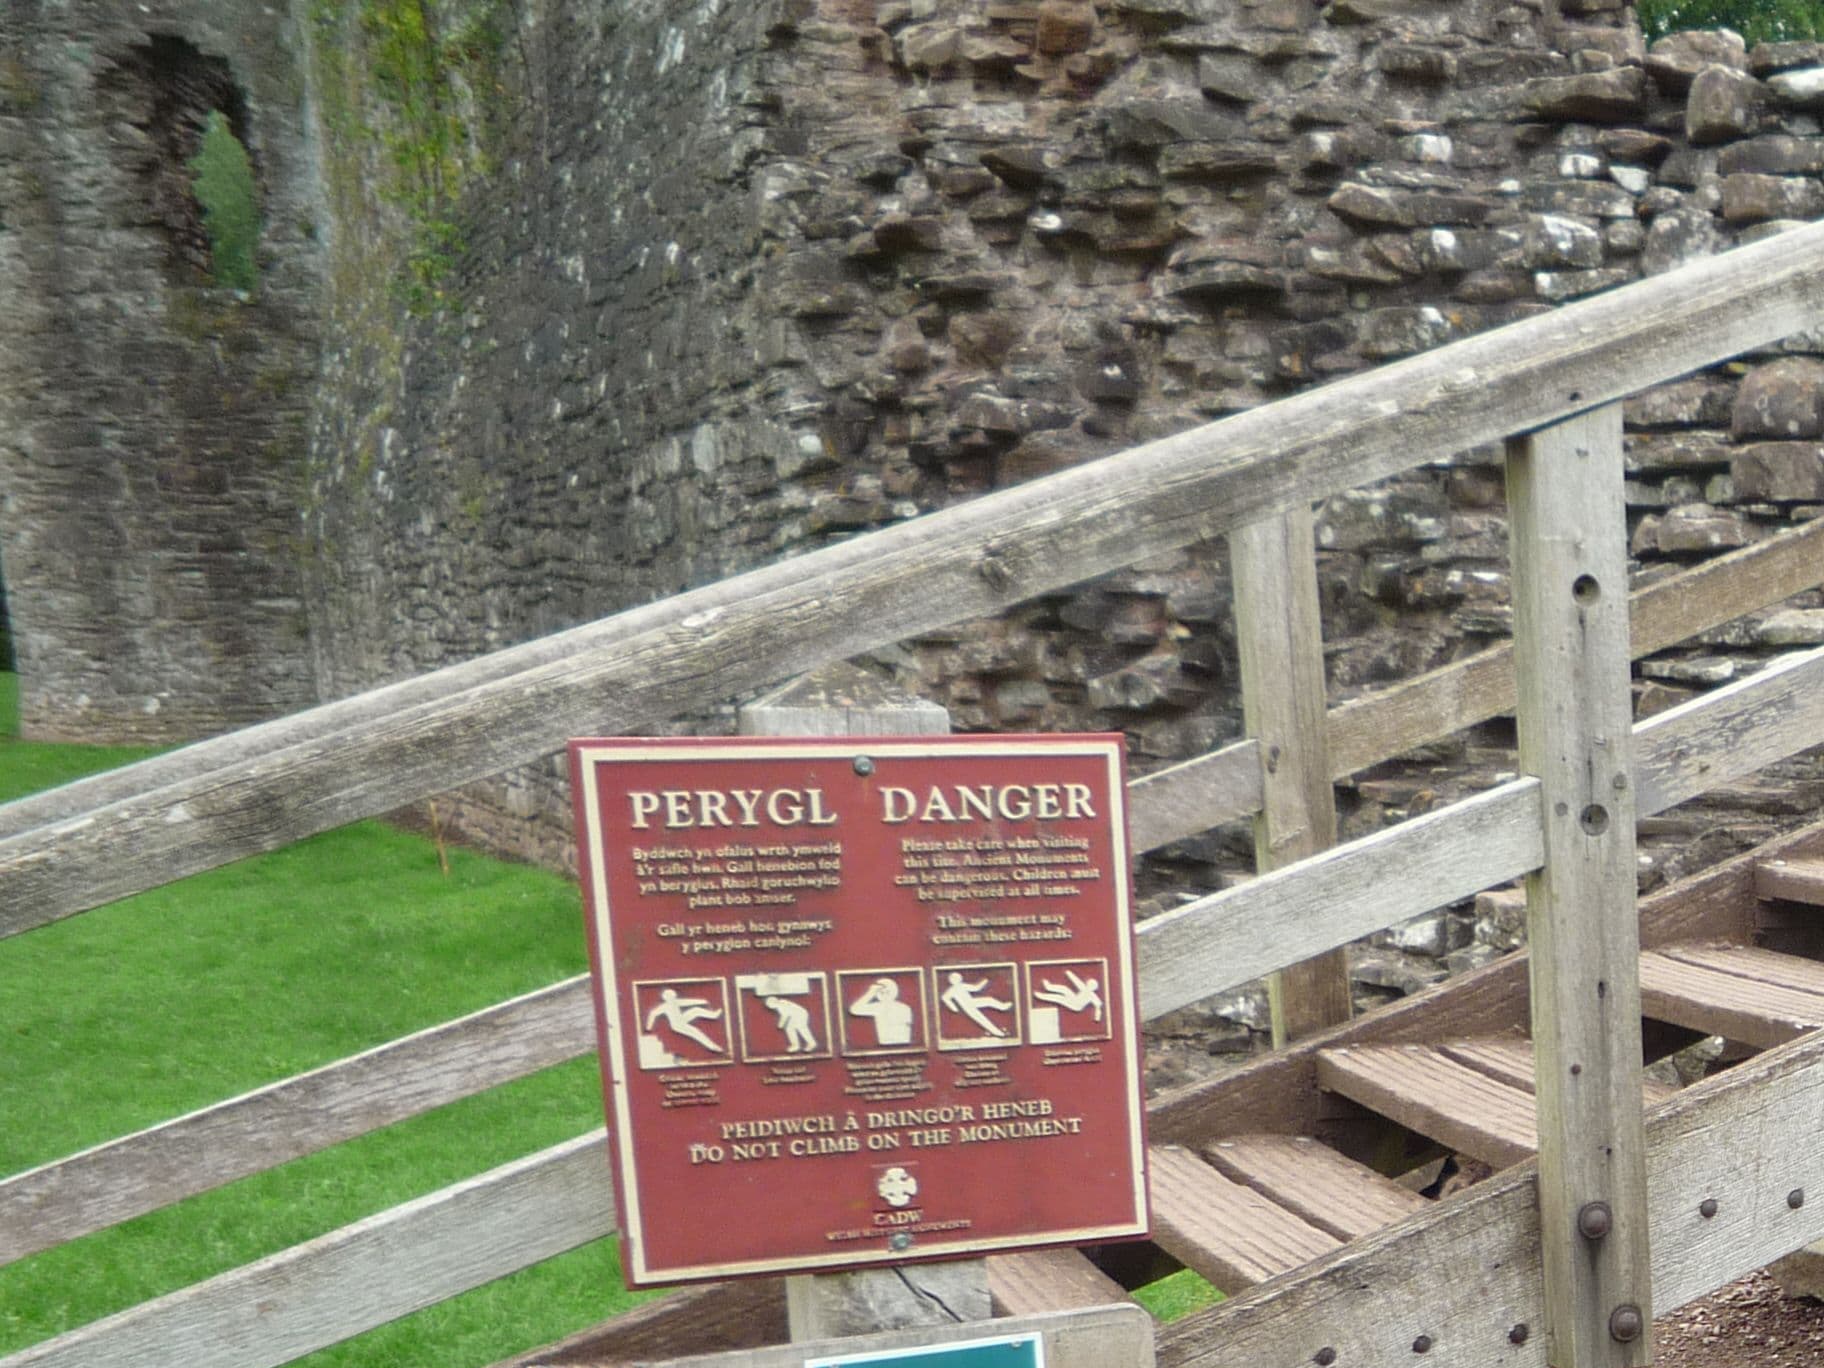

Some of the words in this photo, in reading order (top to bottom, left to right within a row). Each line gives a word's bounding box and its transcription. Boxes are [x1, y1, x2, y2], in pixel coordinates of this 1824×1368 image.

[628, 789, 837, 828] PERYGL
[878, 783, 1096, 822] DANGER
[901, 839, 943, 852] Please
[946, 838, 973, 850] take
[976, 839, 1003, 849] care
[1007, 837, 1039, 848] when
[1042, 834, 1089, 849] visiting
[721, 1116, 835, 1140] PEIDIWCH
[867, 1104, 975, 1130] DRINGO'R
[982, 1099, 1052, 1120] HENEB
[690, 1144, 724, 1164] DO
[732, 1142, 781, 1161] NOT
[790, 1136, 859, 1156] CLIMB
[867, 1132, 900, 1150] ON
[910, 1129, 951, 1147] THE
[960, 1118, 1082, 1143] MONUMENT
[873, 1209, 923, 1225] CADW
